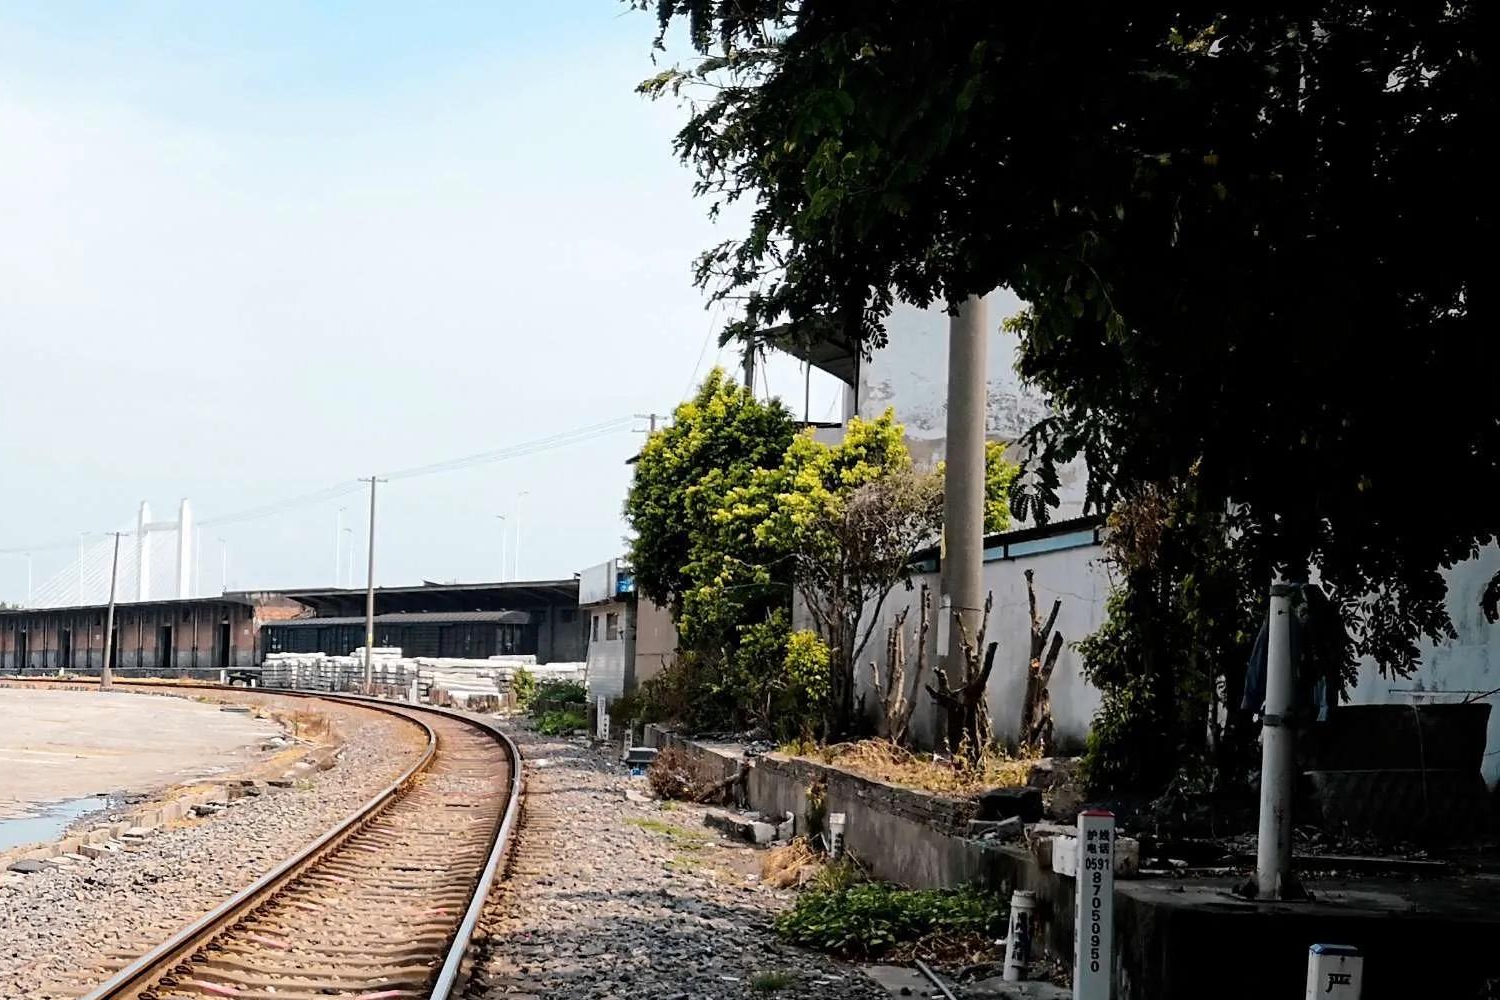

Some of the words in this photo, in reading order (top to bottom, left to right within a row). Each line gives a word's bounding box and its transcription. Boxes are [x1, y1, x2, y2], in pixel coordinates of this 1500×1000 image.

[1087, 843, 1109, 854] 电话
[1086, 857, 1109, 870] 0591
[1091, 872, 1102, 973] 87050950
